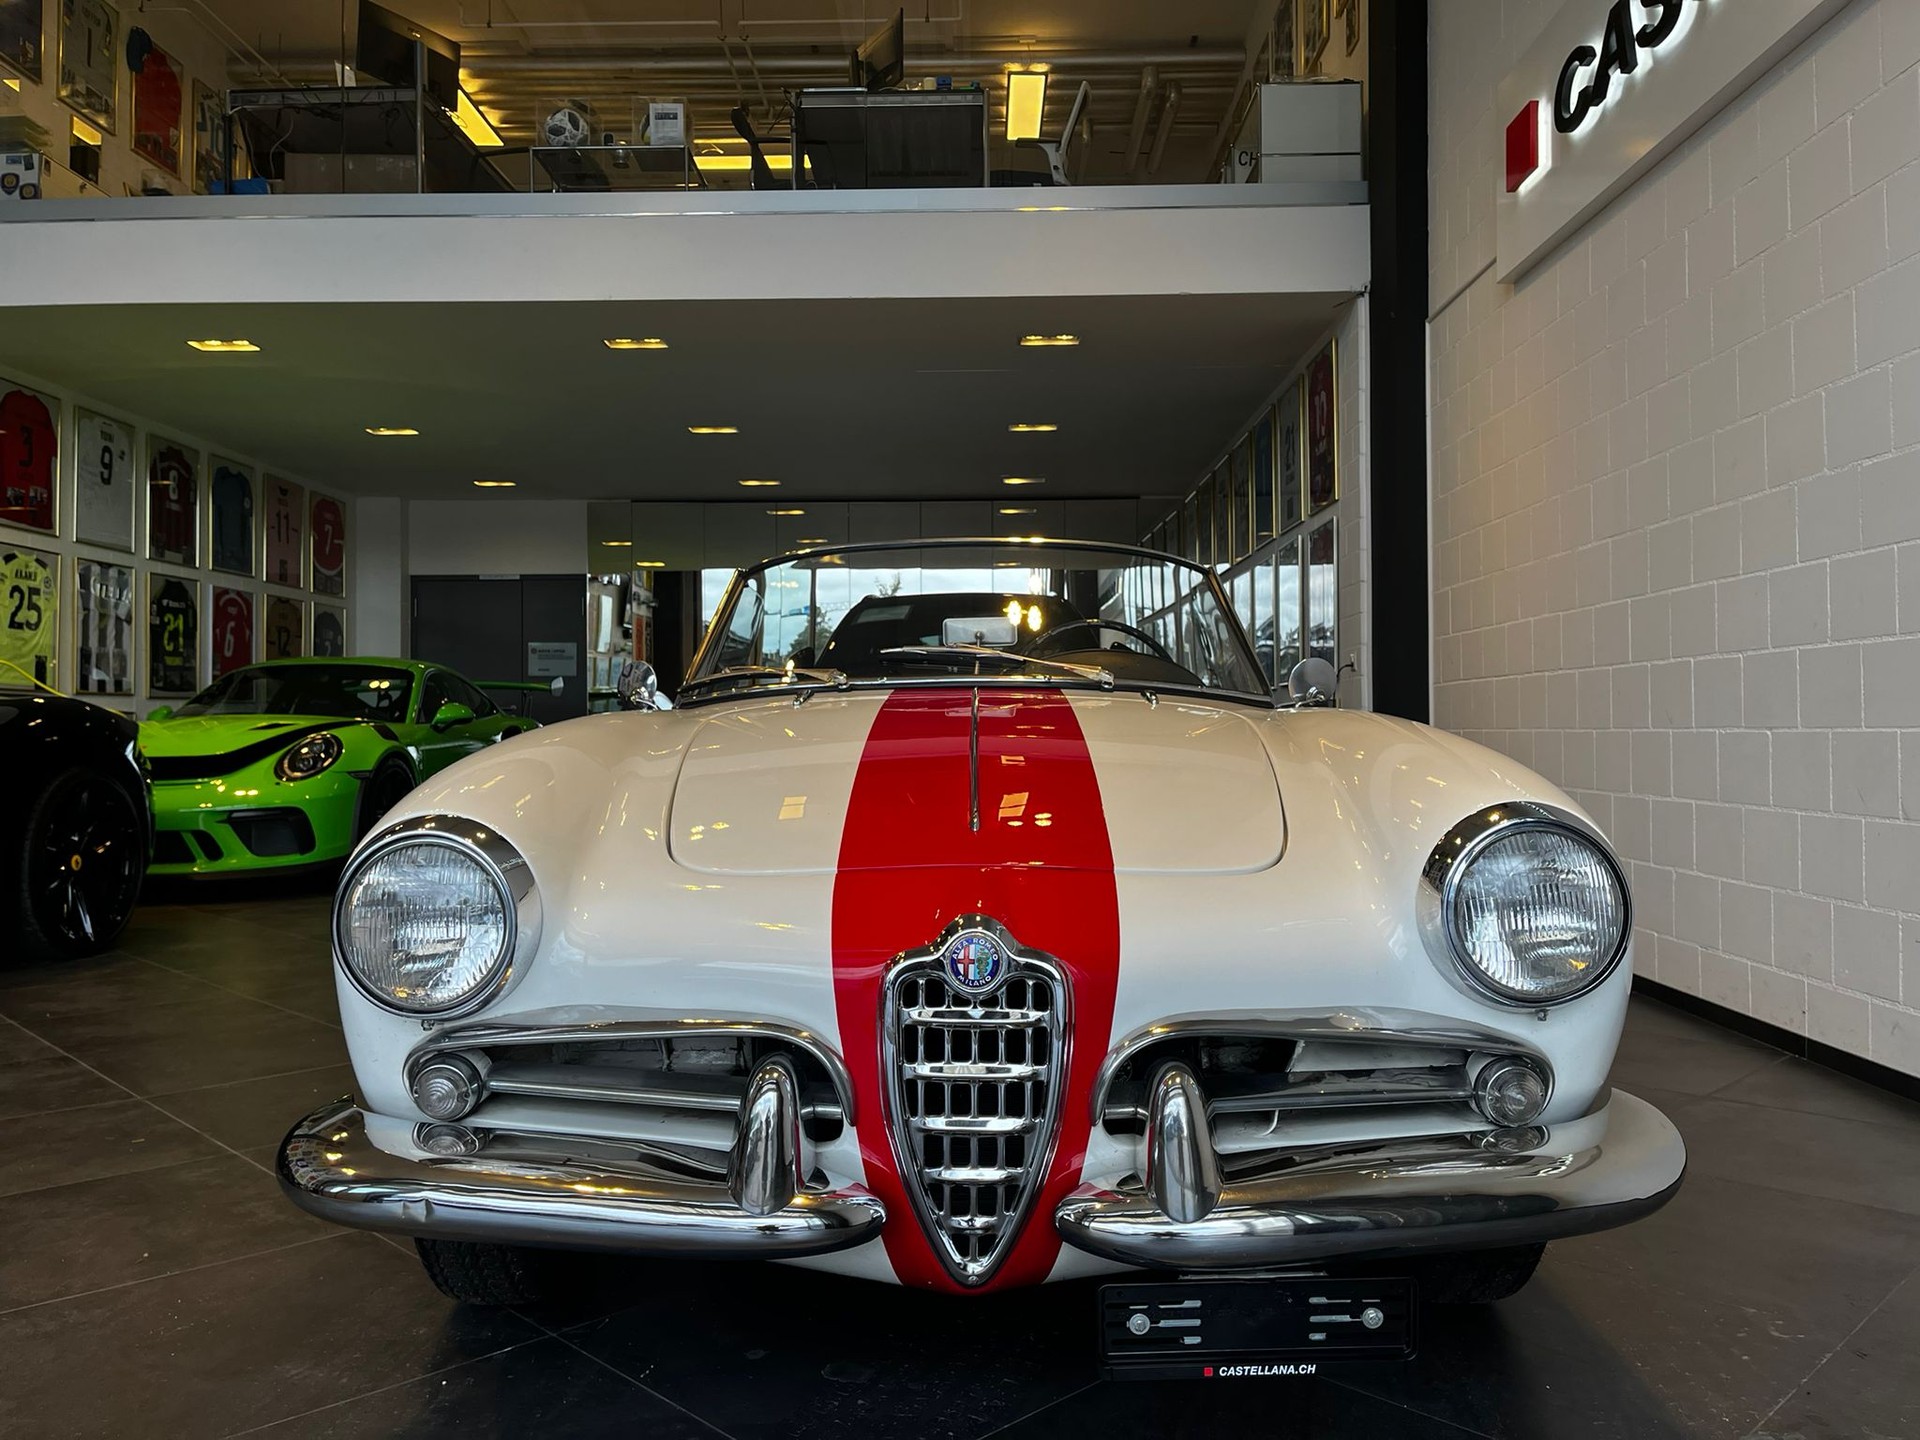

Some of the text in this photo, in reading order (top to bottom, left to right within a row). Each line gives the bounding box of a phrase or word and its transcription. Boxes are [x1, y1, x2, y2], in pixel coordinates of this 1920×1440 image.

[1554, 0, 1702, 133] CAS
[100, 445, 114, 485] 9
[168, 469, 179, 501] 8
[275, 510, 290, 544] 11
[324, 523, 333, 556] 7
[8, 585, 42, 631] 25
[163, 612, 185, 652] 21
[223, 620, 237, 658] 6
[952, 938, 999, 961] ALFA ROMEO
[957, 975, 992, 987] MILANO
[1218, 1364, 1317, 1377] CASTELLANA.CH
